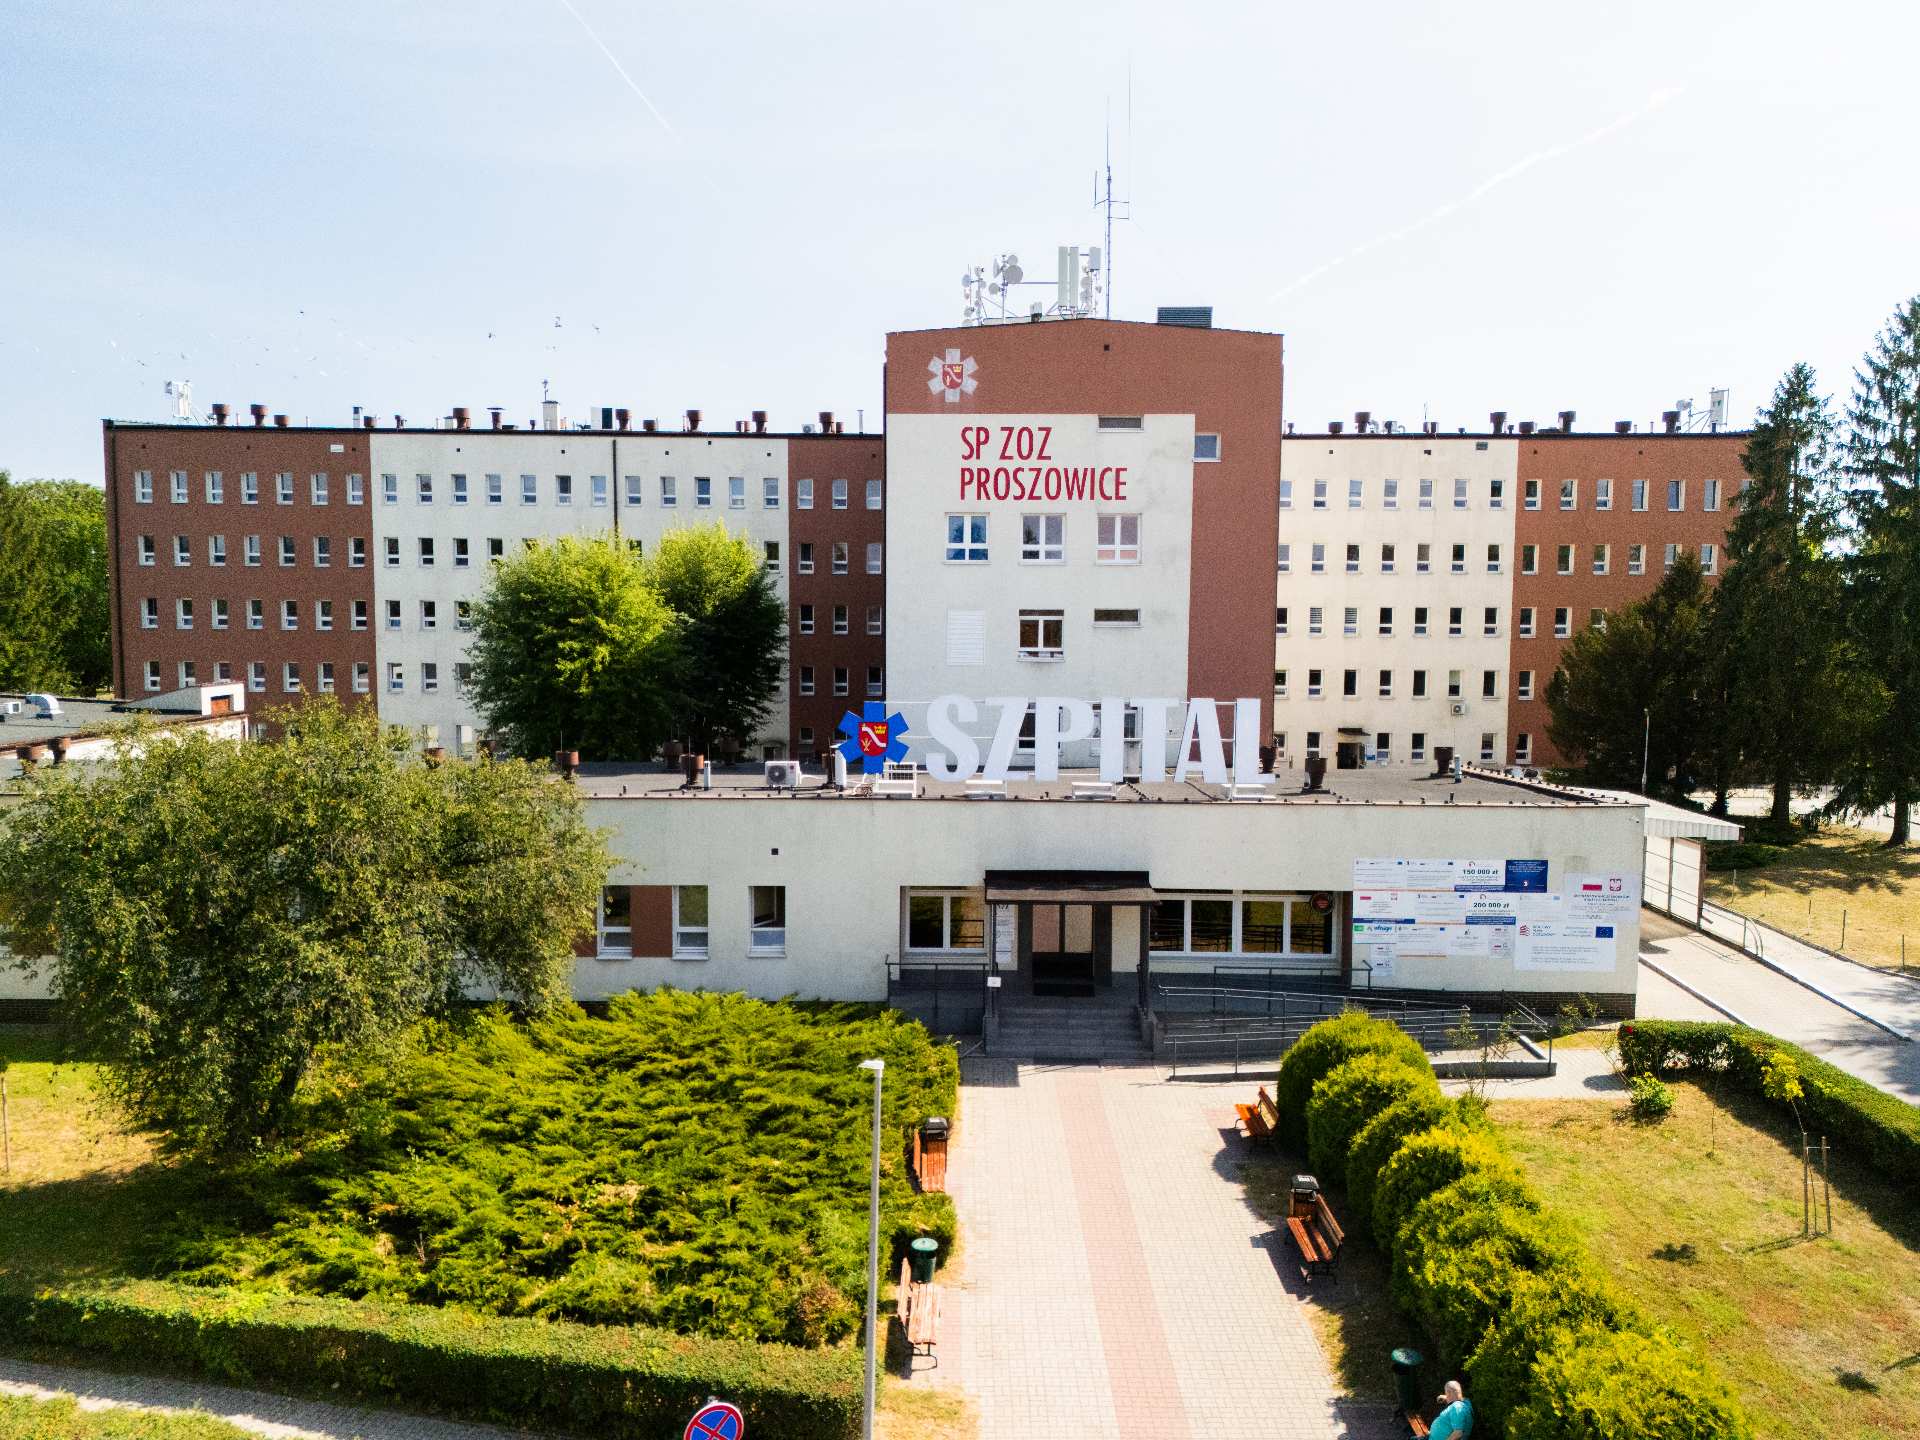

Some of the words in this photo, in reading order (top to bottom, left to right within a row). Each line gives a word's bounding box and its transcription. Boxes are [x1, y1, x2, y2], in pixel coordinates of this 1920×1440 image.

[961, 426, 990, 460] SP
[999, 426, 1053, 460] ZOZ
[960, 467, 1128, 500] PROSZOWICE
[925, 694, 1276, 784] SZPITAL
